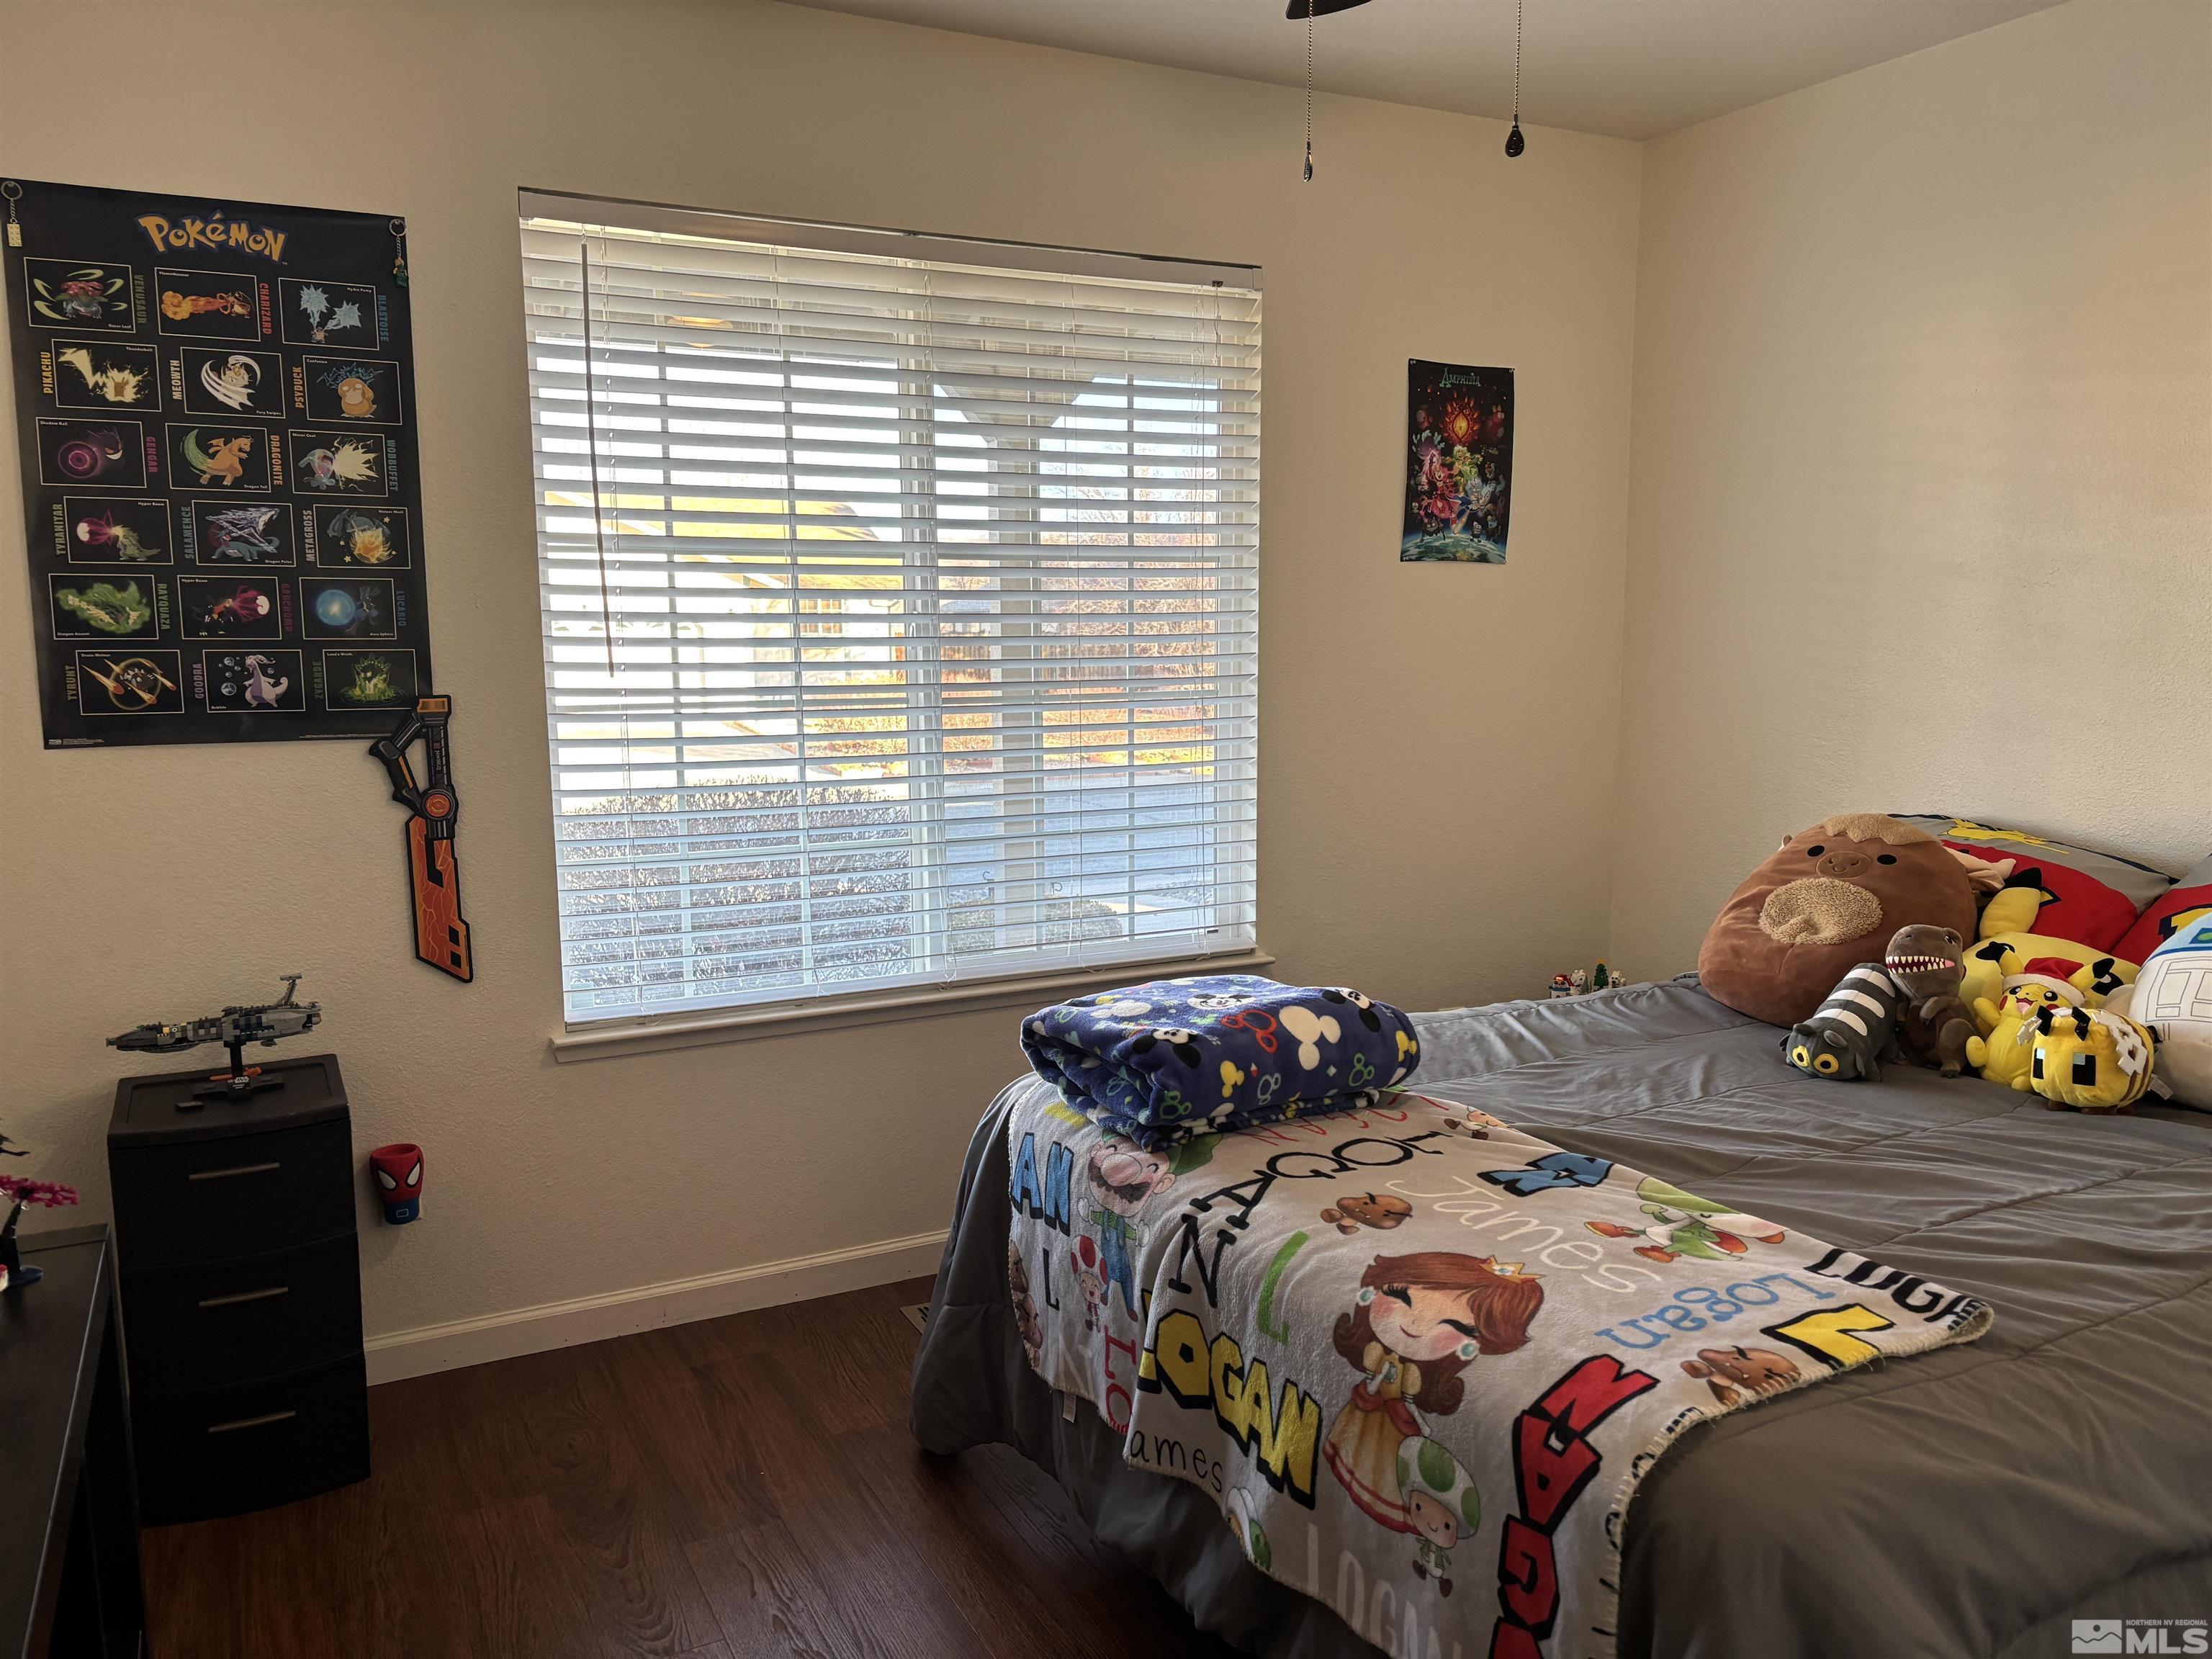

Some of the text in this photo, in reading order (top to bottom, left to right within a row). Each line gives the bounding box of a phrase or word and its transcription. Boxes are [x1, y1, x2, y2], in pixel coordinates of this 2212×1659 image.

[134, 274, 147, 323] VENUSAUR
[259, 282, 273, 336] CHARIZARD
[377, 295, 390, 342] BLASTOISE
[40, 351, 54, 395] PIKACHU
[169, 359, 183, 400] MEOWTH
[292, 366, 305, 409] PSYDUCK
[146, 436, 158, 473] GENGAR
[270, 435, 284, 486] DRAGONITE
[387, 440, 400, 491] WOBBUFFET
[53, 503, 66, 555] TYRANITAR
[181, 506, 195, 559] SALAMENCE
[303, 509, 316, 562] METAGROSS
[158, 583, 171, 631] RAYQUAZA
[397, 590, 408, 627] LUCARIO
[66, 665, 78, 701] TYRUNT
[192, 662, 205, 699] GOODRA
[313, 660, 324, 700] ZYGARDE
[1384, 1174, 1663, 1294] James
[1592, 1271, 1837, 1351] Logan
